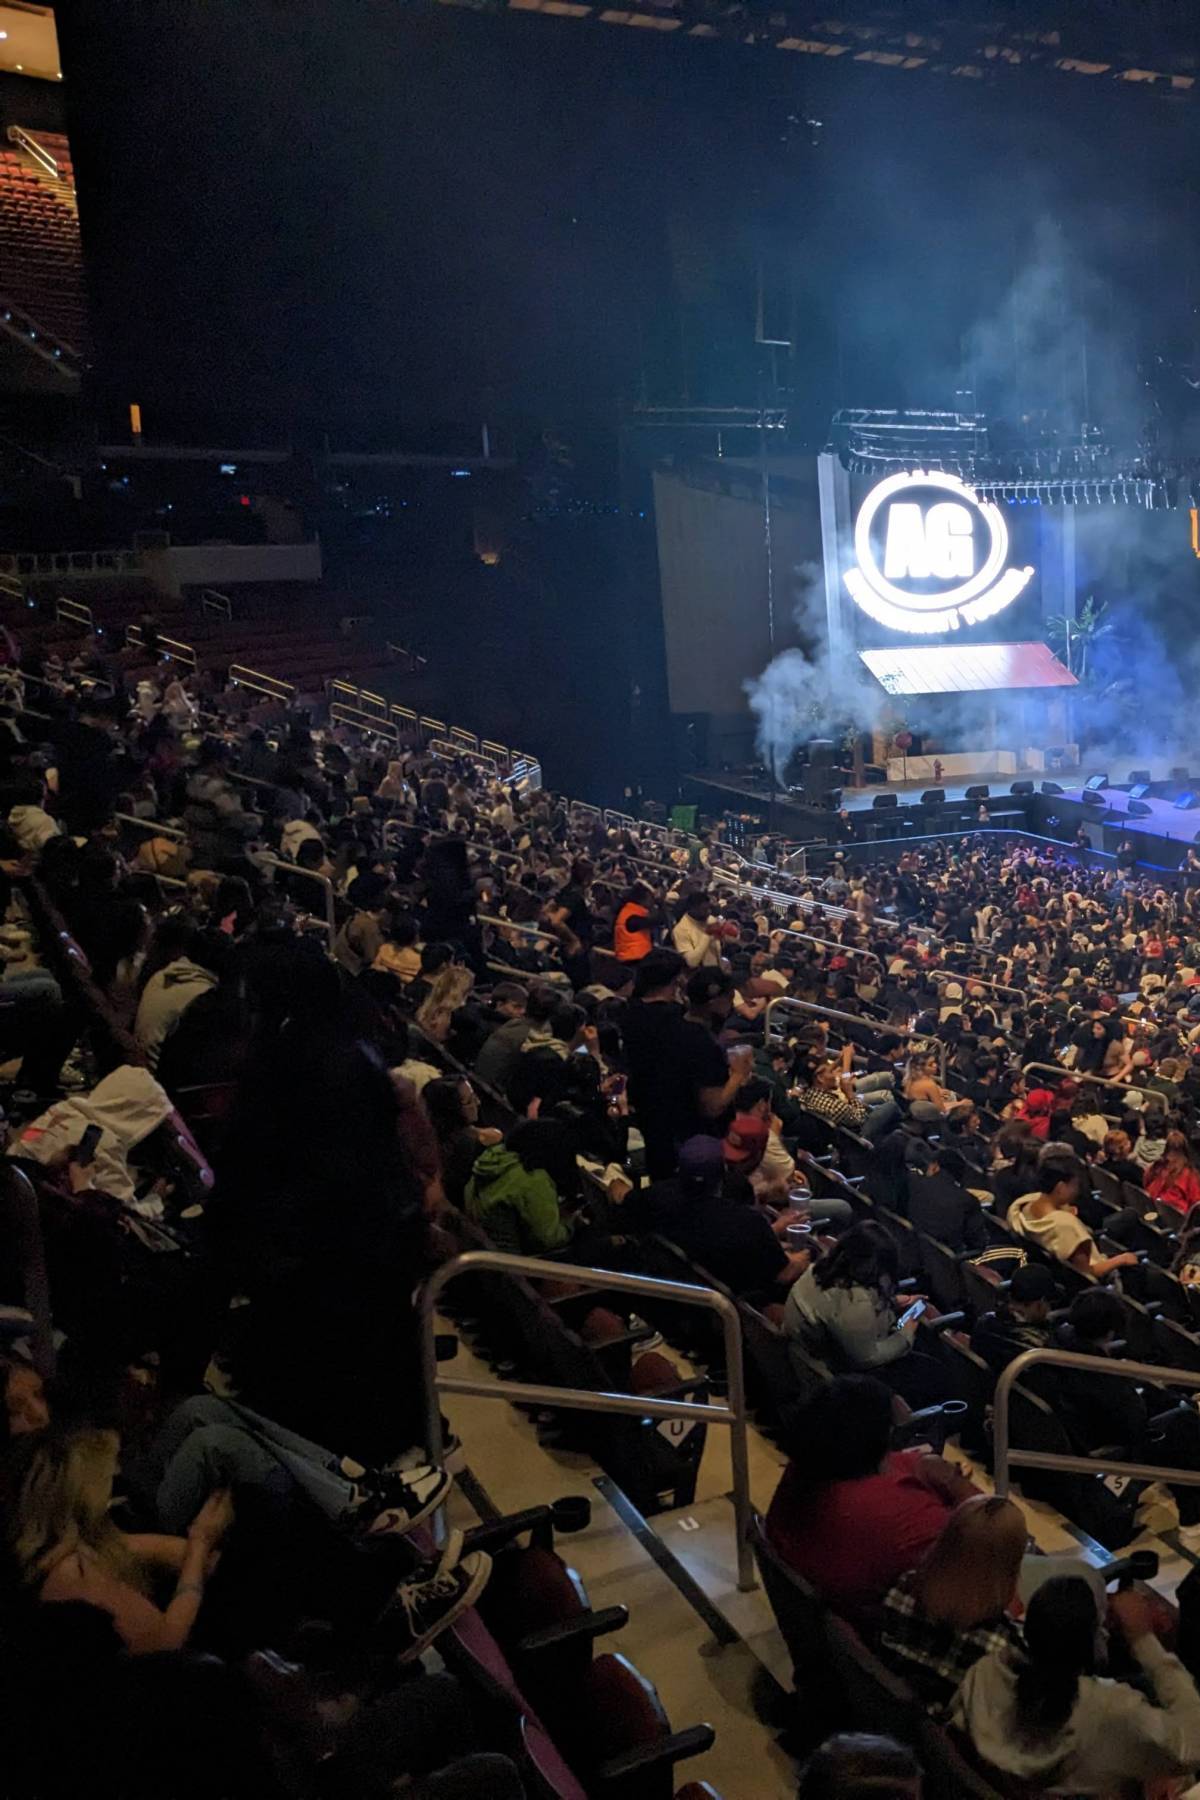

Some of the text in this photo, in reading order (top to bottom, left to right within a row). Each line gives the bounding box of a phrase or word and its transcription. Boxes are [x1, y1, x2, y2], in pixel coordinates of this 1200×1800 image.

[884, 502, 974, 579] AG
[670, 1420, 684, 1436] U
[1114, 1476, 1123, 1490] S
[678, 1516, 700, 1531] U
